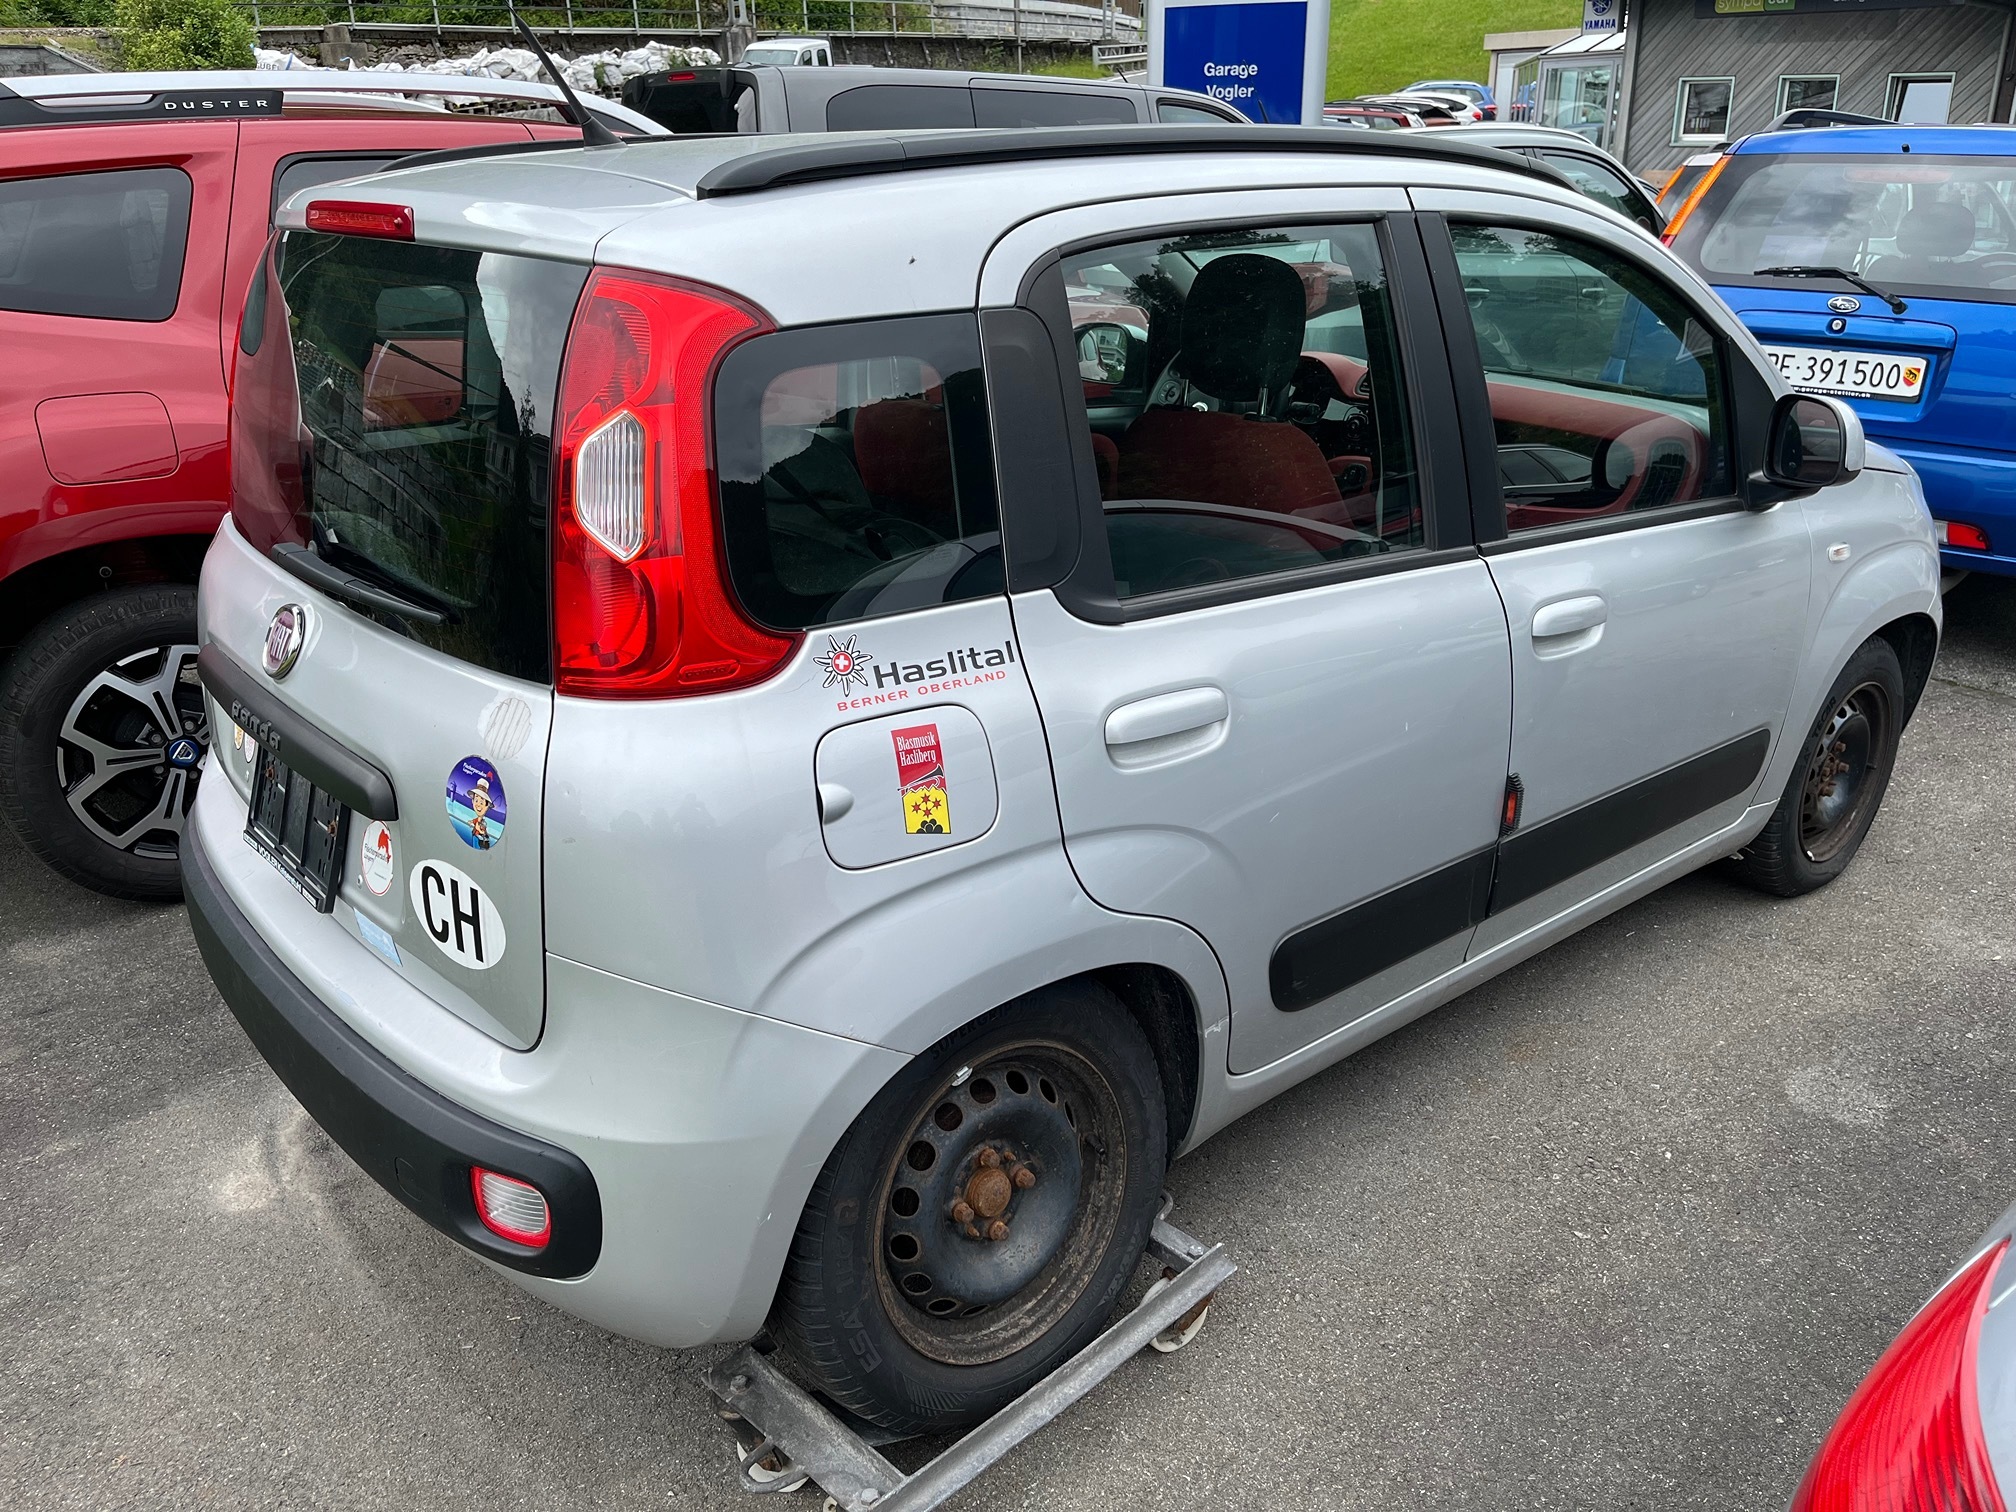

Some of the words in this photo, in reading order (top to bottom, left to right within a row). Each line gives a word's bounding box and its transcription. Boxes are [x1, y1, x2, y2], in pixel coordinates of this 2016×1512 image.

[1584, 18, 1616, 30] YAMAHA
[1203, 62, 1258, 79] Garage
[1206, 84, 1255, 101] Vogler
[164, 100, 268, 110] DUSTER
[270, 621, 293, 661] FIAT
[872, 640, 1015, 689] Haslital
[837, 689, 909, 712] BERNER
[917, 669, 1007, 696] OBERLAND
[896, 731, 937, 752] Blasmusik
[899, 748, 937, 767] Hasliberg
[421, 865, 484, 963] CH
